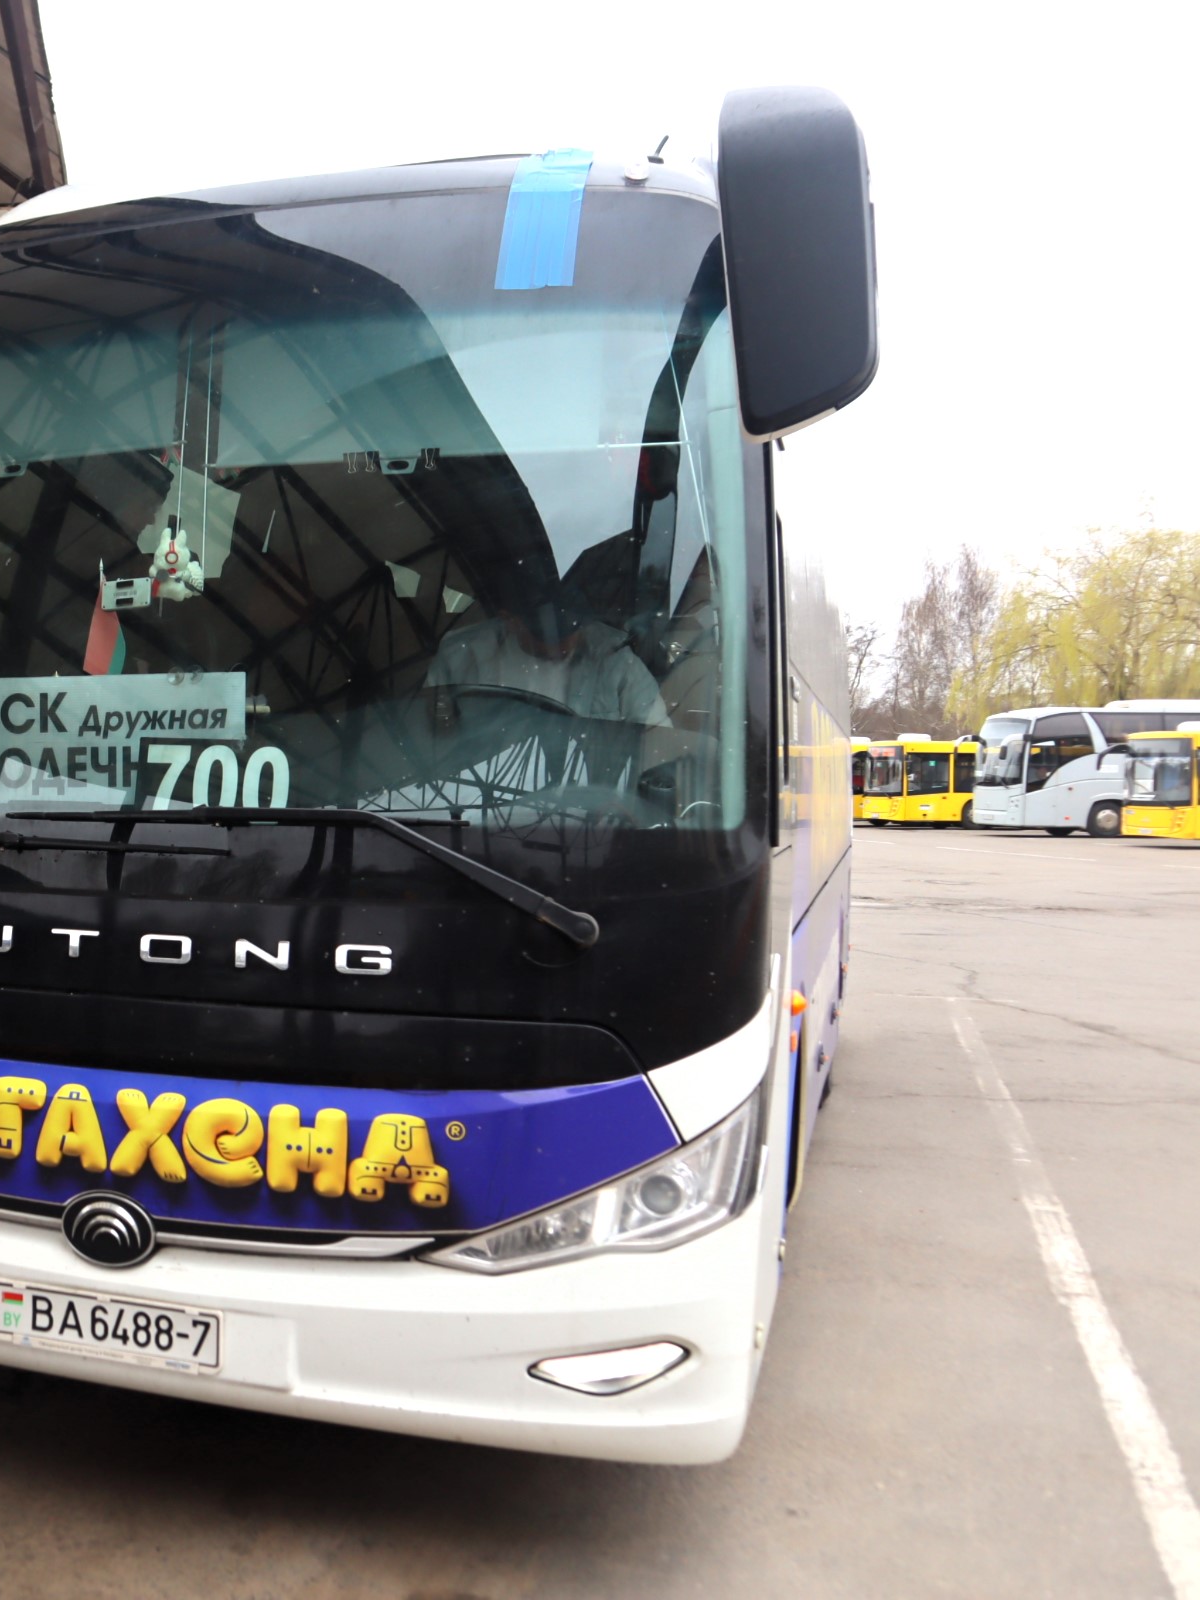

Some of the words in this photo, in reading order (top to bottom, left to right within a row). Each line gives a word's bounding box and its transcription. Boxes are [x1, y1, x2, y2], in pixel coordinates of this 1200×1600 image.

[78, 704, 228, 739] Дружная
[146, 744, 291, 812] 700
[2, 1311, 22, 1328] BY
